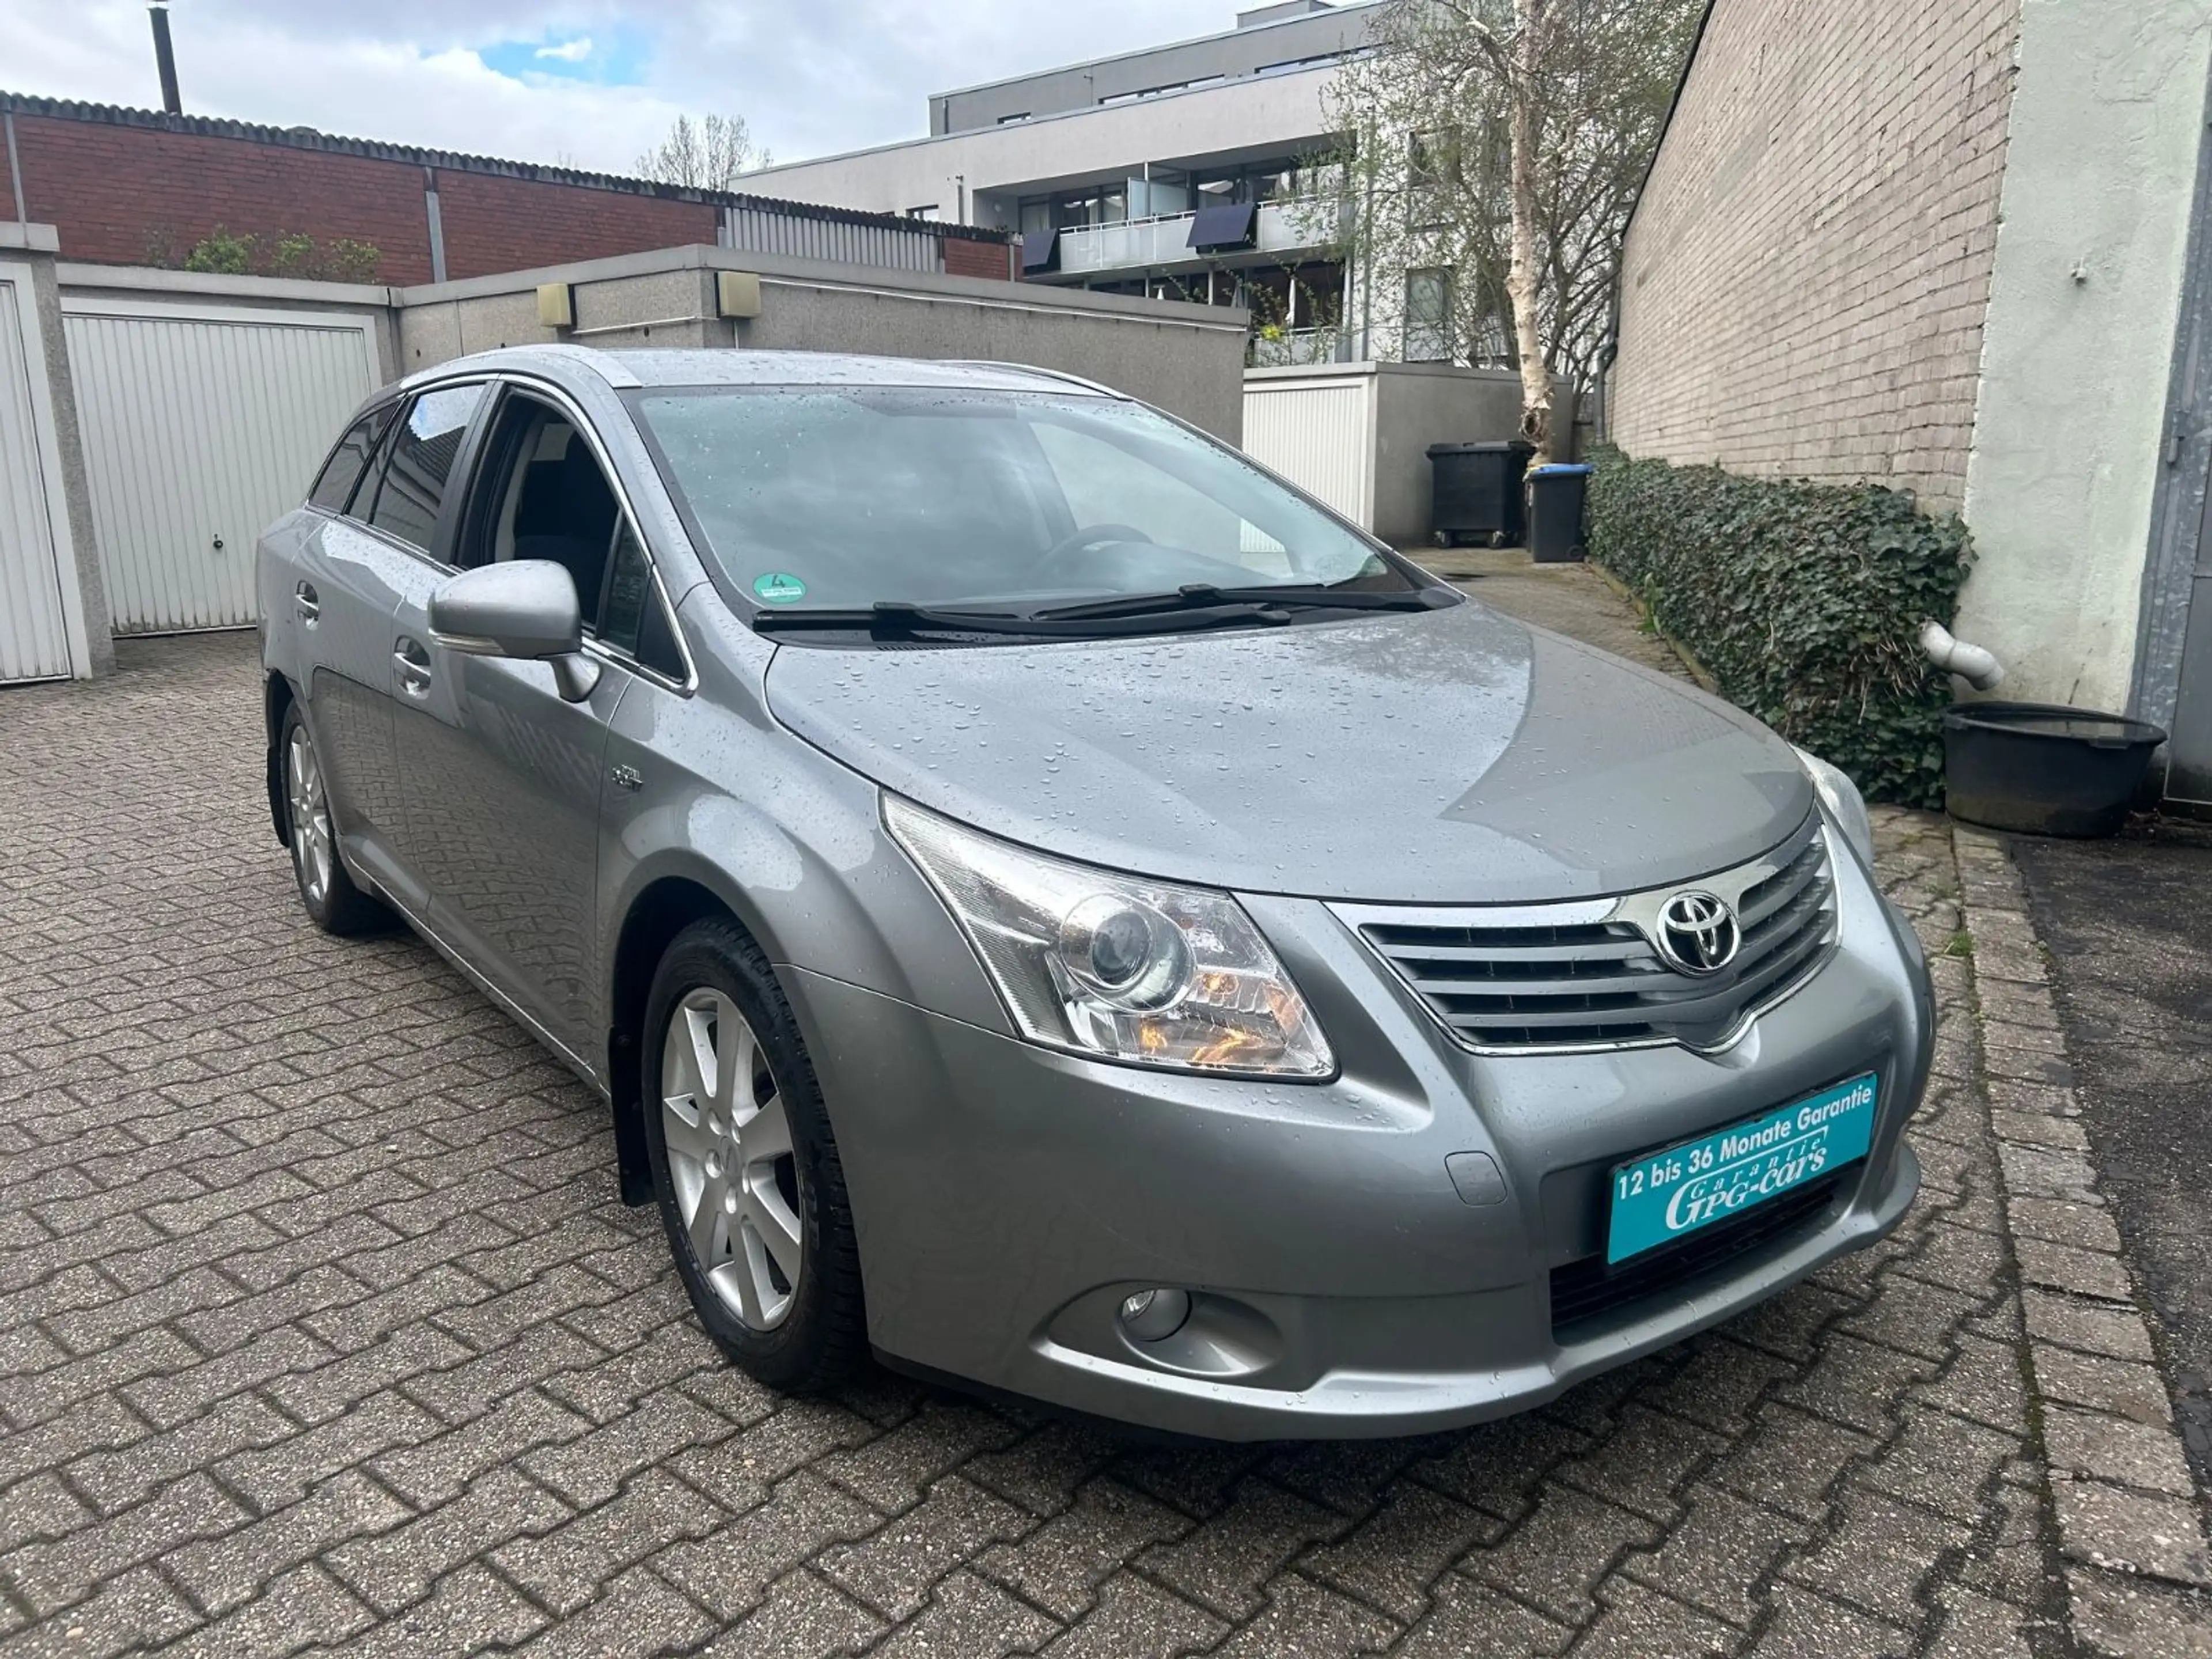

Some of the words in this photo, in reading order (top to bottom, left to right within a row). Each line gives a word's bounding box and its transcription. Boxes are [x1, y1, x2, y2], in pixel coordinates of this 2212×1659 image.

[1619, 1170, 1643, 1200] 12
[1650, 1158, 1681, 1188] bis
[1688, 1145, 1713, 1174] 36
[1719, 1119, 1791, 1162] Monate
[1797, 1084, 1872, 1131] Garantie
